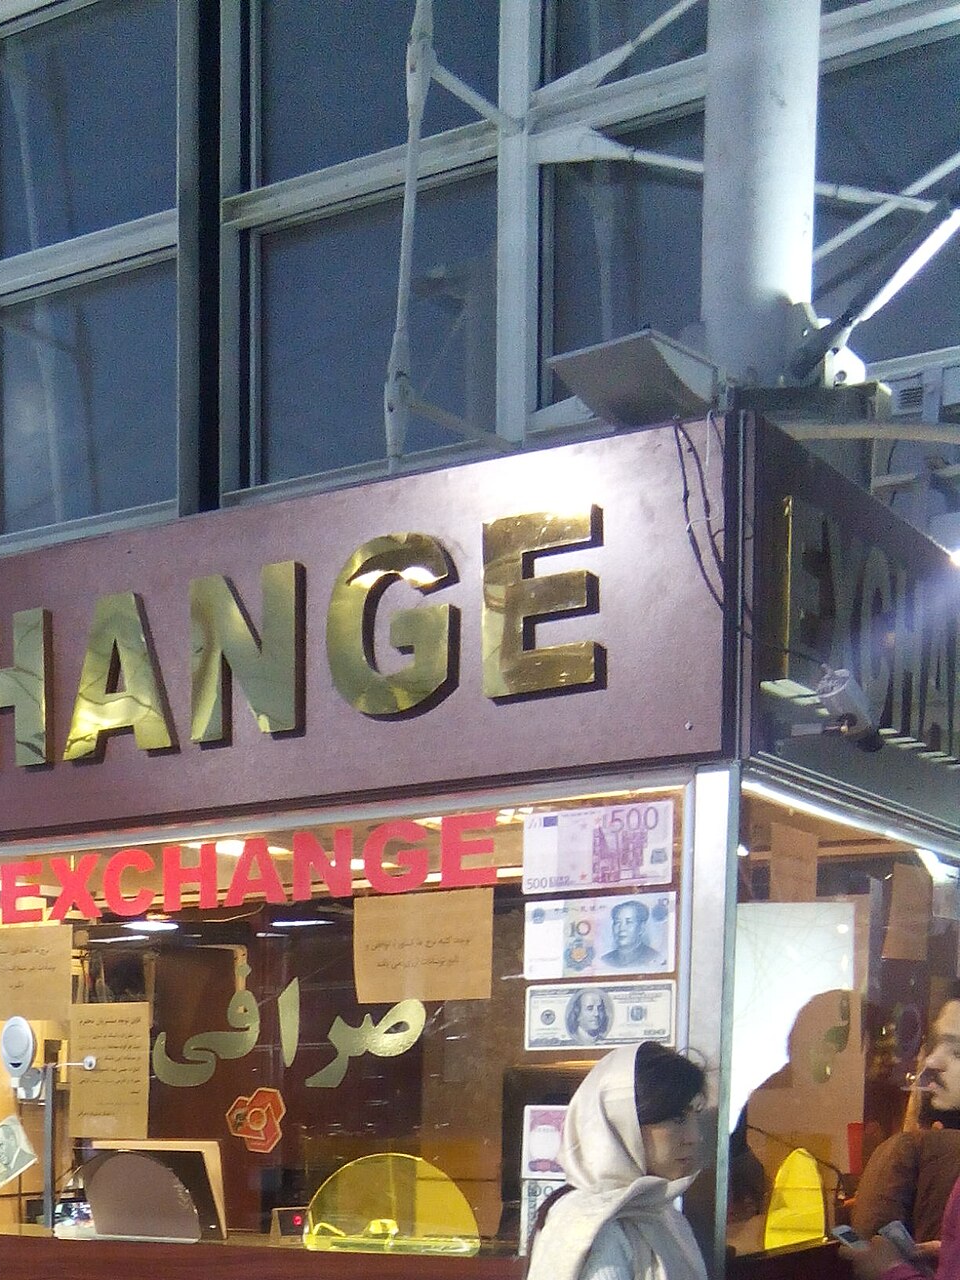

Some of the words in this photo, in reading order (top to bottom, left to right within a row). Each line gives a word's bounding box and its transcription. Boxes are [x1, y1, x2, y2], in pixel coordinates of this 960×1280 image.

[612, 806, 659, 833] 500
[0, 811, 497, 926] EXCHANGE
[526, 877, 548, 890] 500
[568, 920, 591, 937] 10
[152, 963, 427, 1089] صرافی
